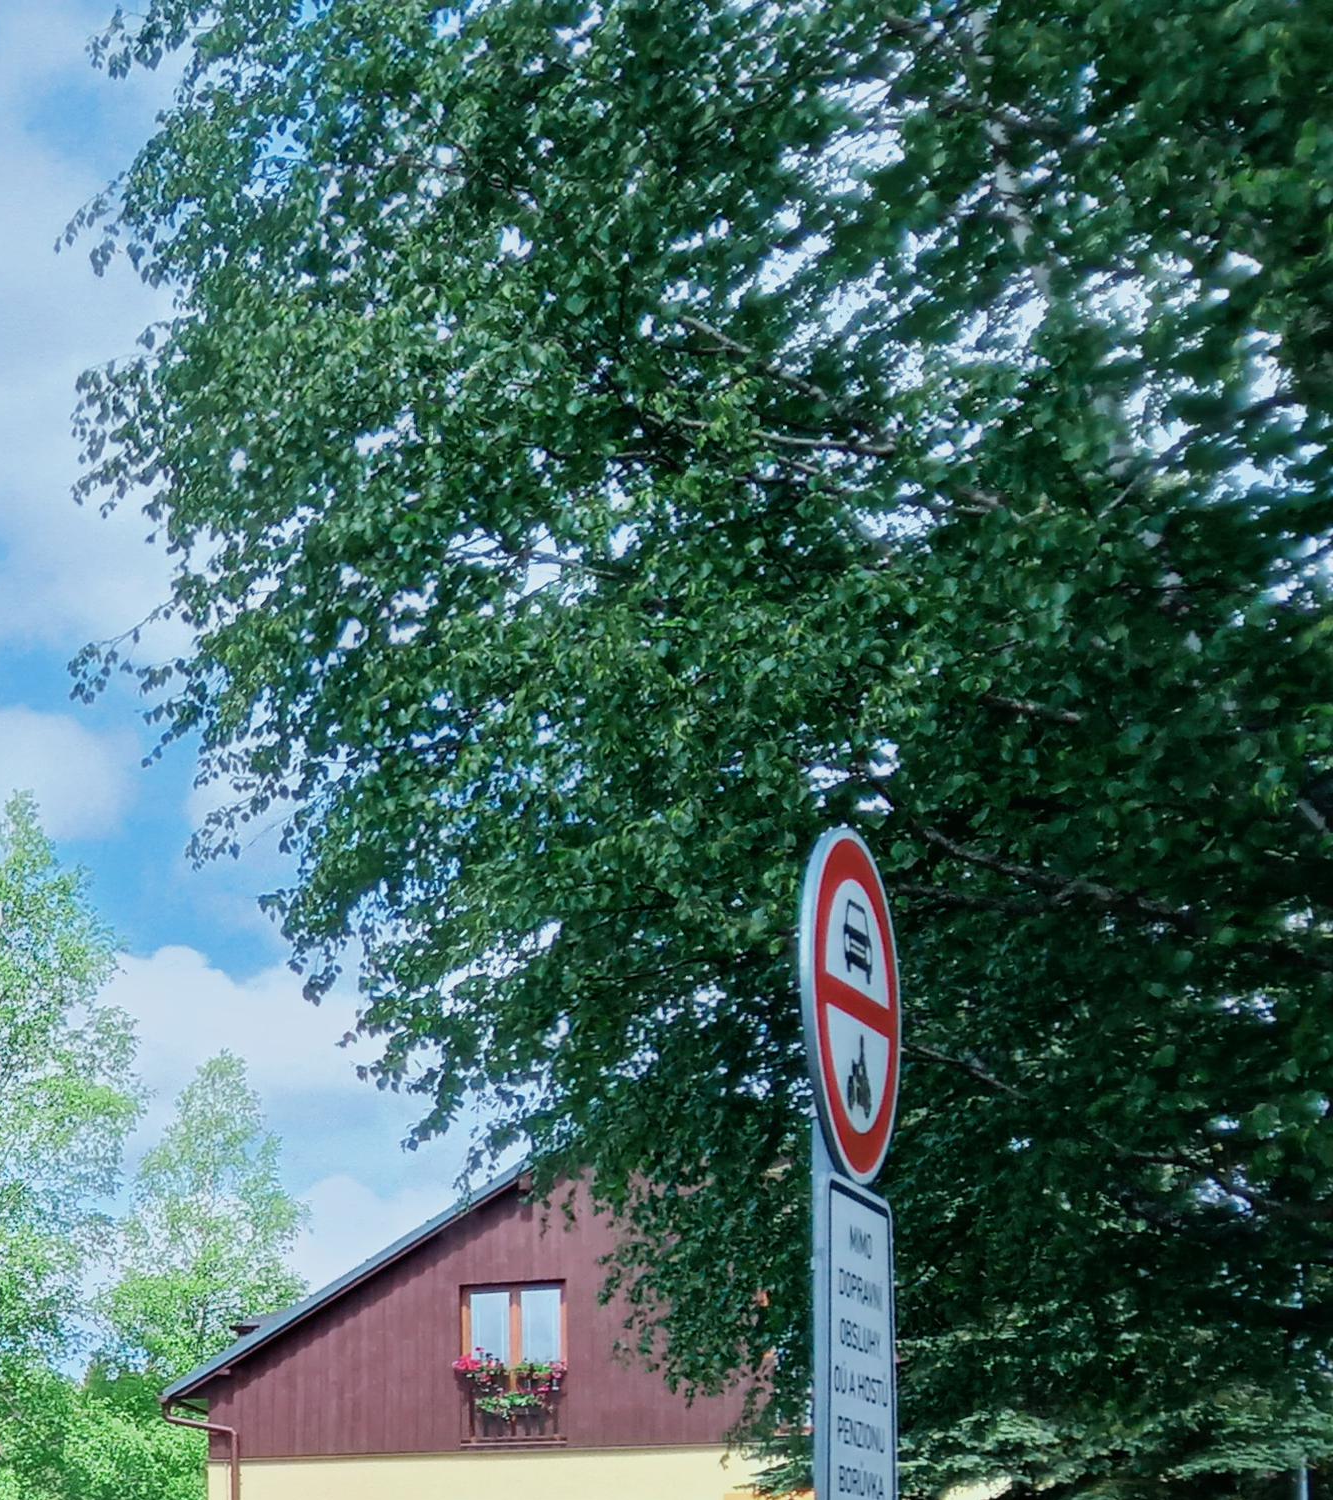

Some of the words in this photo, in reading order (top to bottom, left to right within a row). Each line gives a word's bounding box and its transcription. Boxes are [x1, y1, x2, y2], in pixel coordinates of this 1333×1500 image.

[849, 1223, 873, 1260] MIMO
[849, 1370, 856, 1398] A
[857, 1372, 889, 1407] HOSTŮ
[837, 1415, 886, 1454] PENZIONU
[838, 1461, 885, 1500] BORŮVKA
